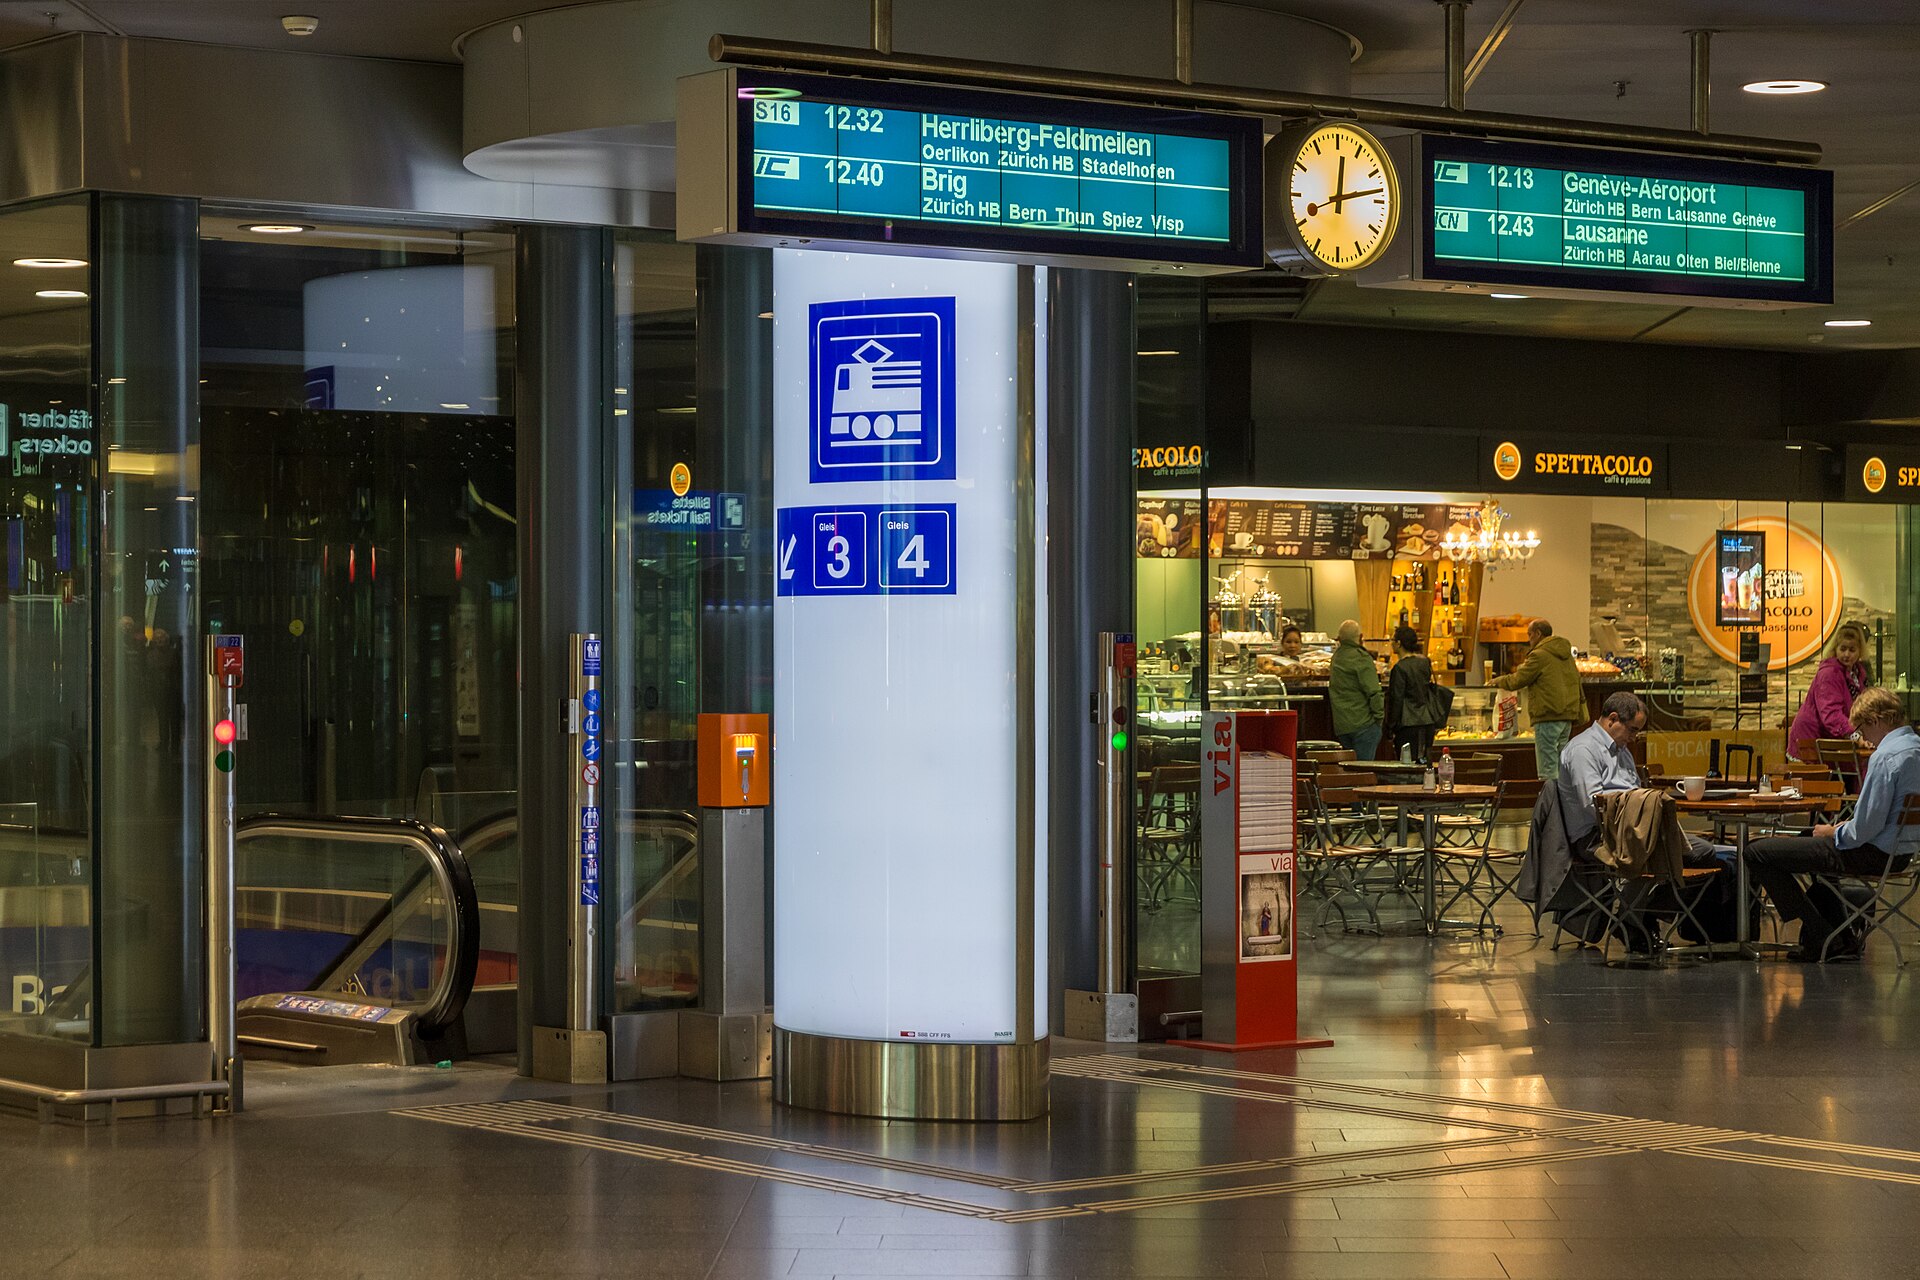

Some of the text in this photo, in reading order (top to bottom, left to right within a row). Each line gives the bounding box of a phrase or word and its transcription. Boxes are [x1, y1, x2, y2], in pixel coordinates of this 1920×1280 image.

[755, 101, 791, 121] S16
[824, 105, 884, 133] 12.32
[922, 113, 1151, 156] Herrliberg-Feldmeilen
[824, 159, 884, 187] 12.40
[922, 143, 1175, 180] Oerlikon Zürich HB Stadelhofen
[922, 167, 967, 199] Brig
[1487, 165, 1534, 189] 12.13
[1563, 172, 1716, 207] Genève-Aéroport
[923, 198, 1184, 235] Zürich HB Bern Thun Spiez Visp
[1487, 213, 1534, 237] 12.43
[1563, 198, 1777, 228] Zürich HB Bern Lausanne Genève
[1563, 219, 1648, 245] Lausanne
[1563, 245, 1781, 274] Zürich HB Aarau Olten Biel/Bienne
[1535, 452, 1653, 476] SPETTACOLO
[1898, 466, 1920, 486] SP
[1625, 476, 1652, 486] passione
[818, 522, 836, 532] Gleis
[887, 521, 909, 530] Gleis
[826, 535, 850, 579] 3
[897, 534, 930, 578] 4
[1206, 715, 1233, 796] via
[1271, 853, 1293, 871] via
